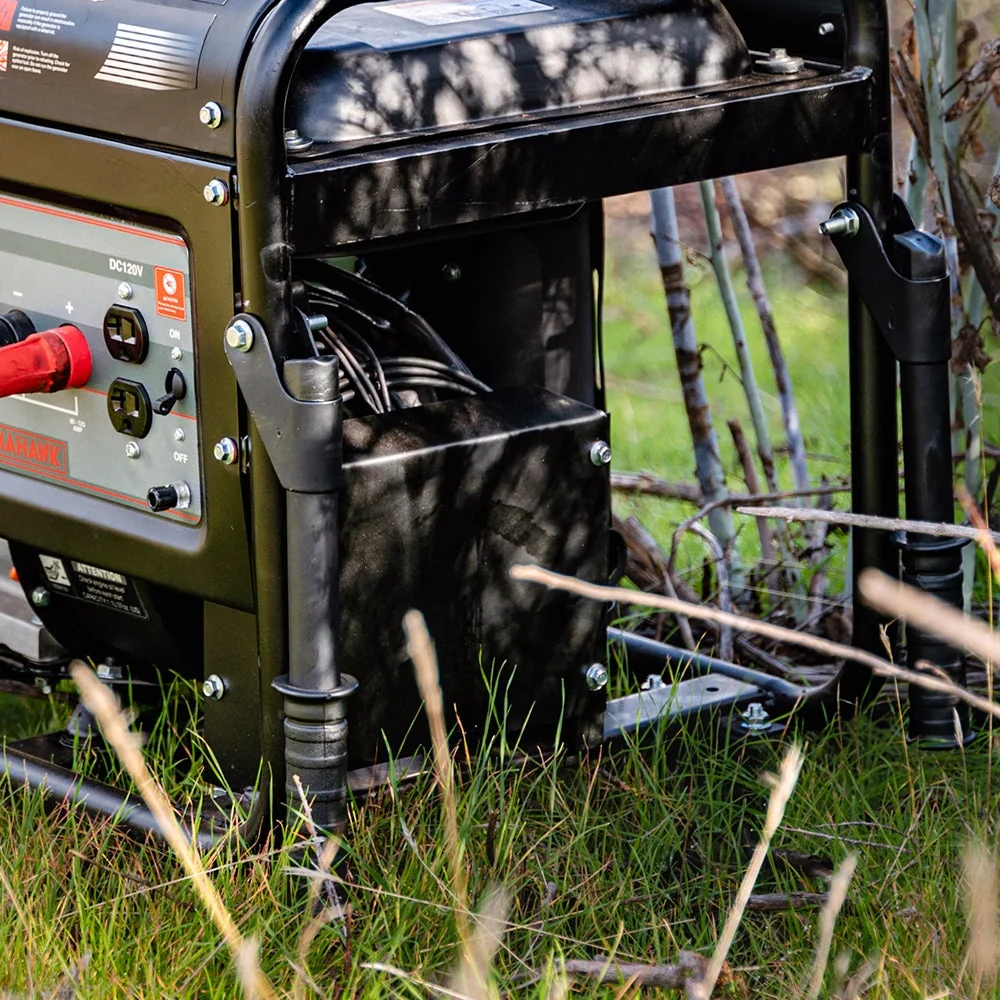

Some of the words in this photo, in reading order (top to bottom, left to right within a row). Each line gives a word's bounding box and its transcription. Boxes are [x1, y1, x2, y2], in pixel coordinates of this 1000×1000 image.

[109, 258, 144, 277] DC120V
[169, 328, 181, 340] ON
[174, 451, 189, 464] OFF
[76, 562, 123, 584] ATTENTION
